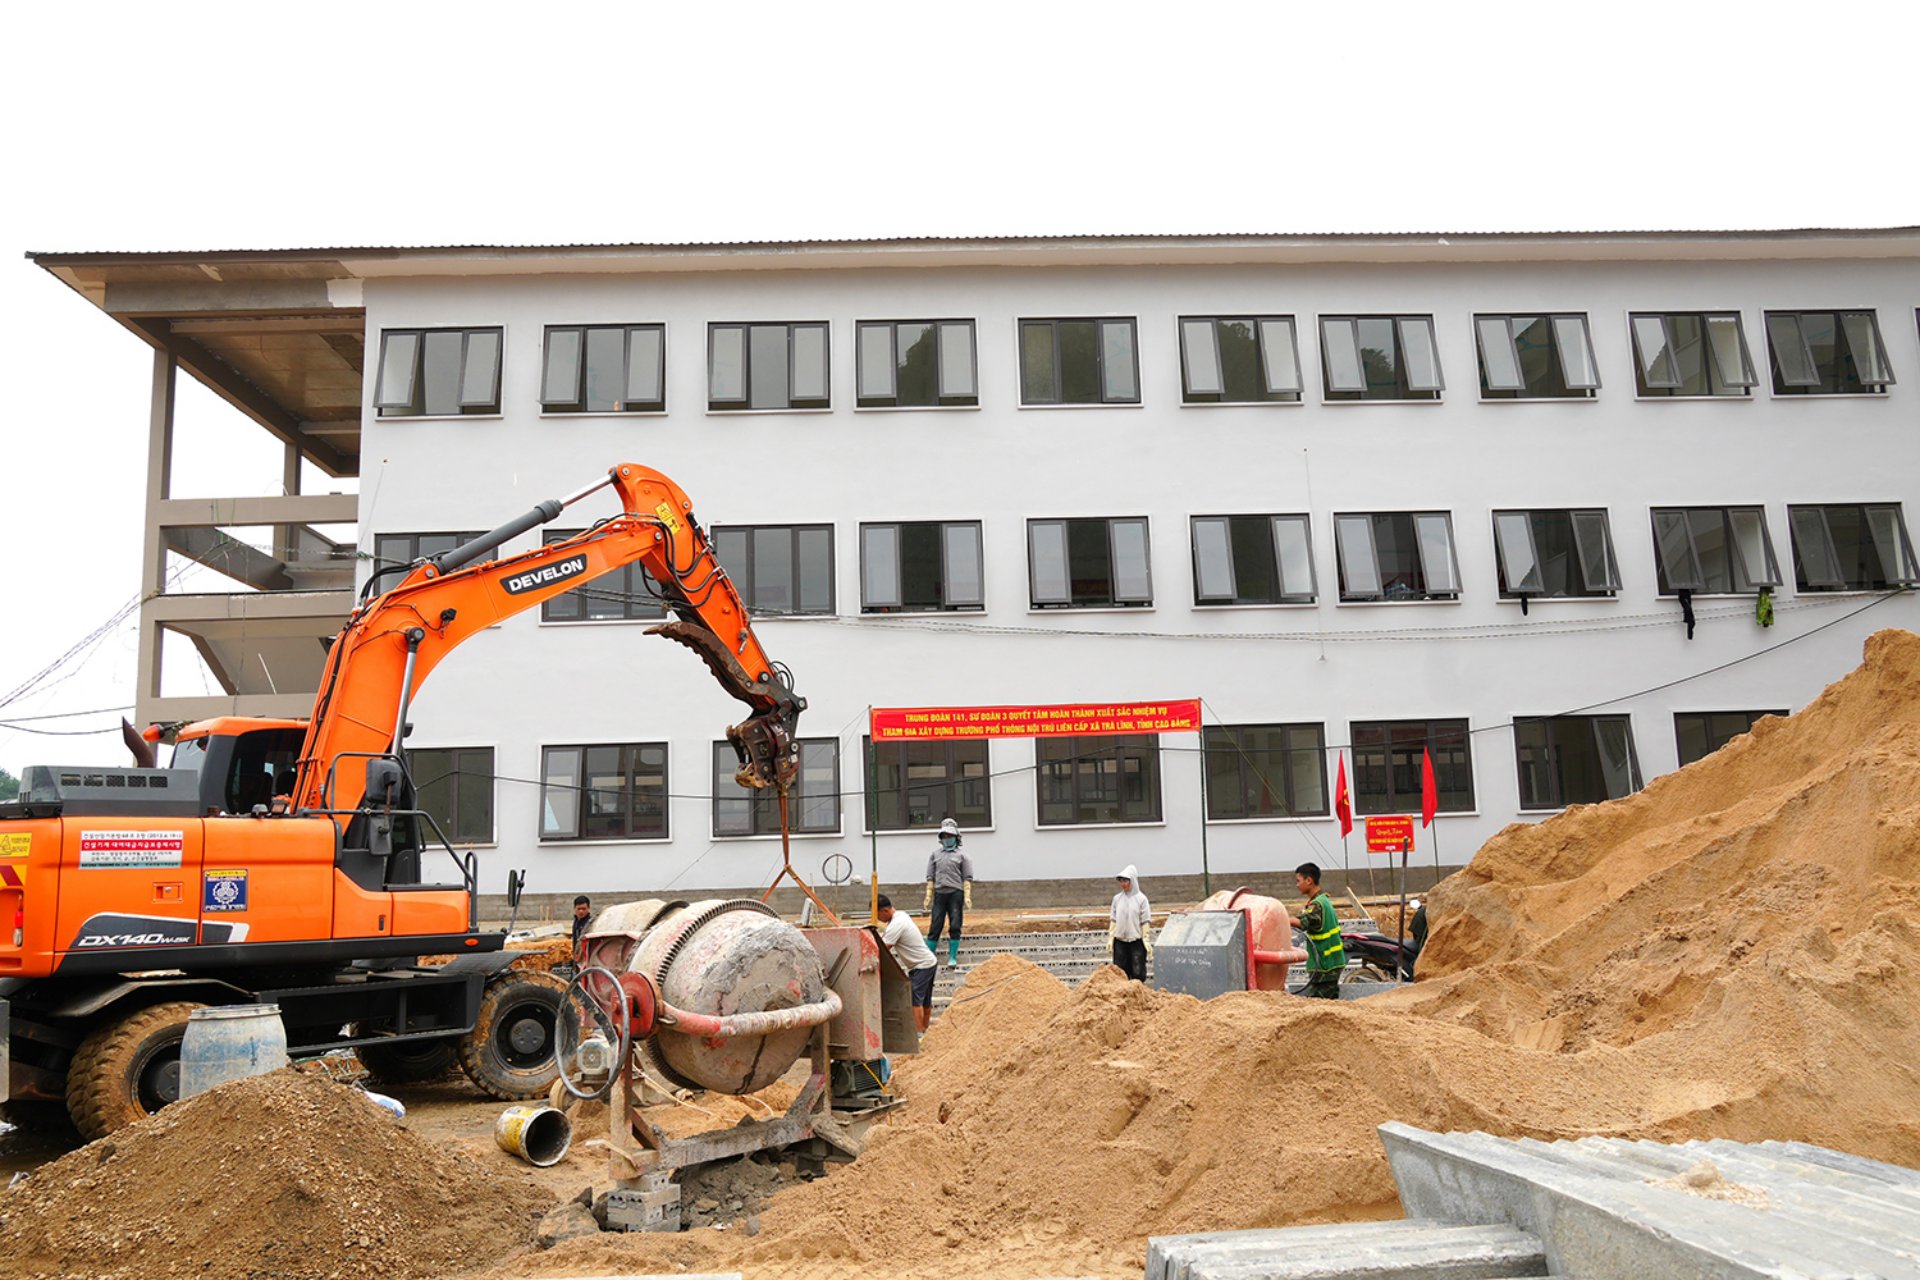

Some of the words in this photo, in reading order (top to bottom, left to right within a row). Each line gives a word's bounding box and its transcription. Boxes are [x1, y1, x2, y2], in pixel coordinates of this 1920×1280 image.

[508, 559, 584, 592] DEVELON
[905, 713, 929, 722] TRUNG
[930, 712, 951, 722] ĐOÀN
[1002, 712, 1007, 721] 3
[1008, 710, 1032, 720] QUYẾT
[1032, 709, 1049, 719] TÂM
[1050, 708, 1070, 718] HOÀN
[1071, 707, 1095, 718] THÀNH
[1096, 706, 1115, 717] XUẤT
[1116, 705, 1132, 716] SẮC
[1132, 705, 1157, 717] NHIỆM
[1157, 706, 1168, 717] VỤ
[882, 727, 903, 737] THAM
[904, 727, 917, 736] GIA
[918, 726, 933, 736] XÂY
[933, 726, 954, 737] DỰNG
[955, 725, 984, 735] TRƯỜNG
[985, 723, 1001, 734] PHỔ
[1001, 724, 1026, 734] THÔNG
[1026, 722, 1040, 734] NỘI
[1041, 722, 1055, 733] TRÚ
[1055, 721, 1072, 732] LIÊN
[1073, 720, 1089, 731] CẤP
[1101, 720, 1116, 730] TRÀ
[1154, 720, 1170, 729] CAO
[1170, 718, 1191, 729] BẰNG
